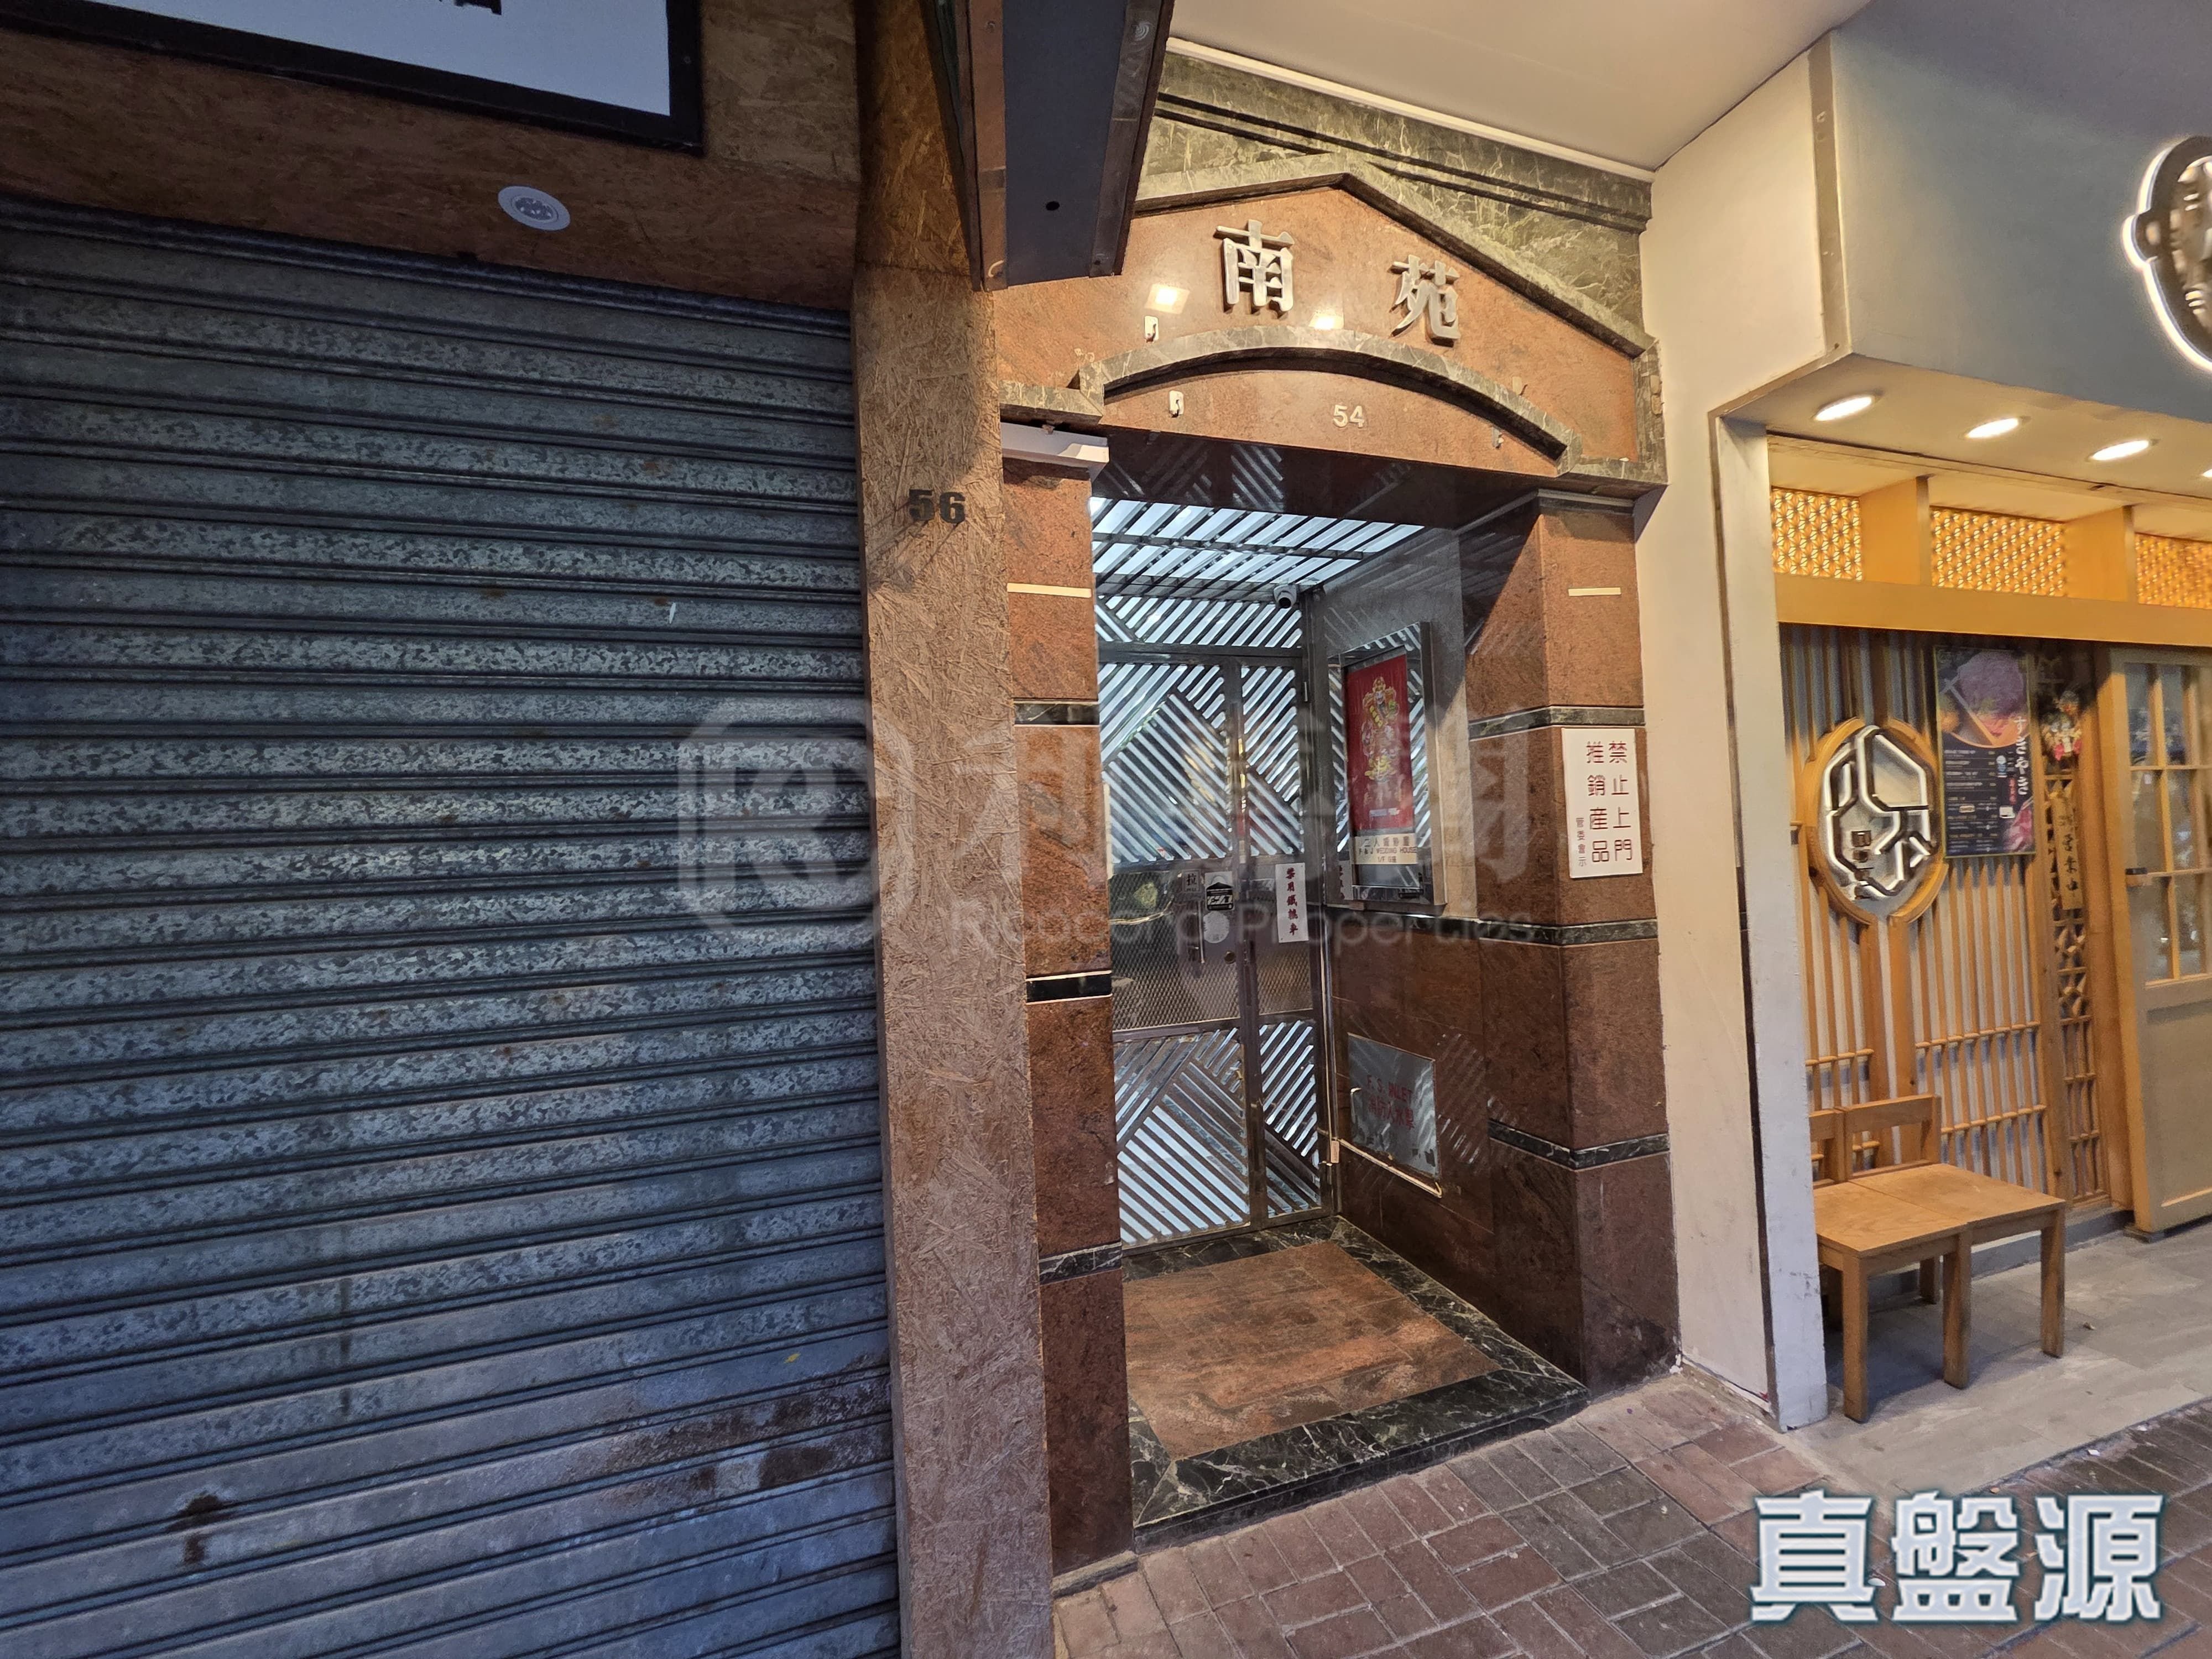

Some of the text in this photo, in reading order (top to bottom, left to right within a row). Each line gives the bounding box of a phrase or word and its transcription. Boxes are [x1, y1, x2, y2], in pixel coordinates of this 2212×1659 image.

[1214, 219, 1462, 346] 南苑
[1332, 404, 1364, 429] 54
[909, 488, 966, 524] 56
[1609, 740, 1633, 862] 禁止上門
[1389, 1082, 1414, 1105] INLET
